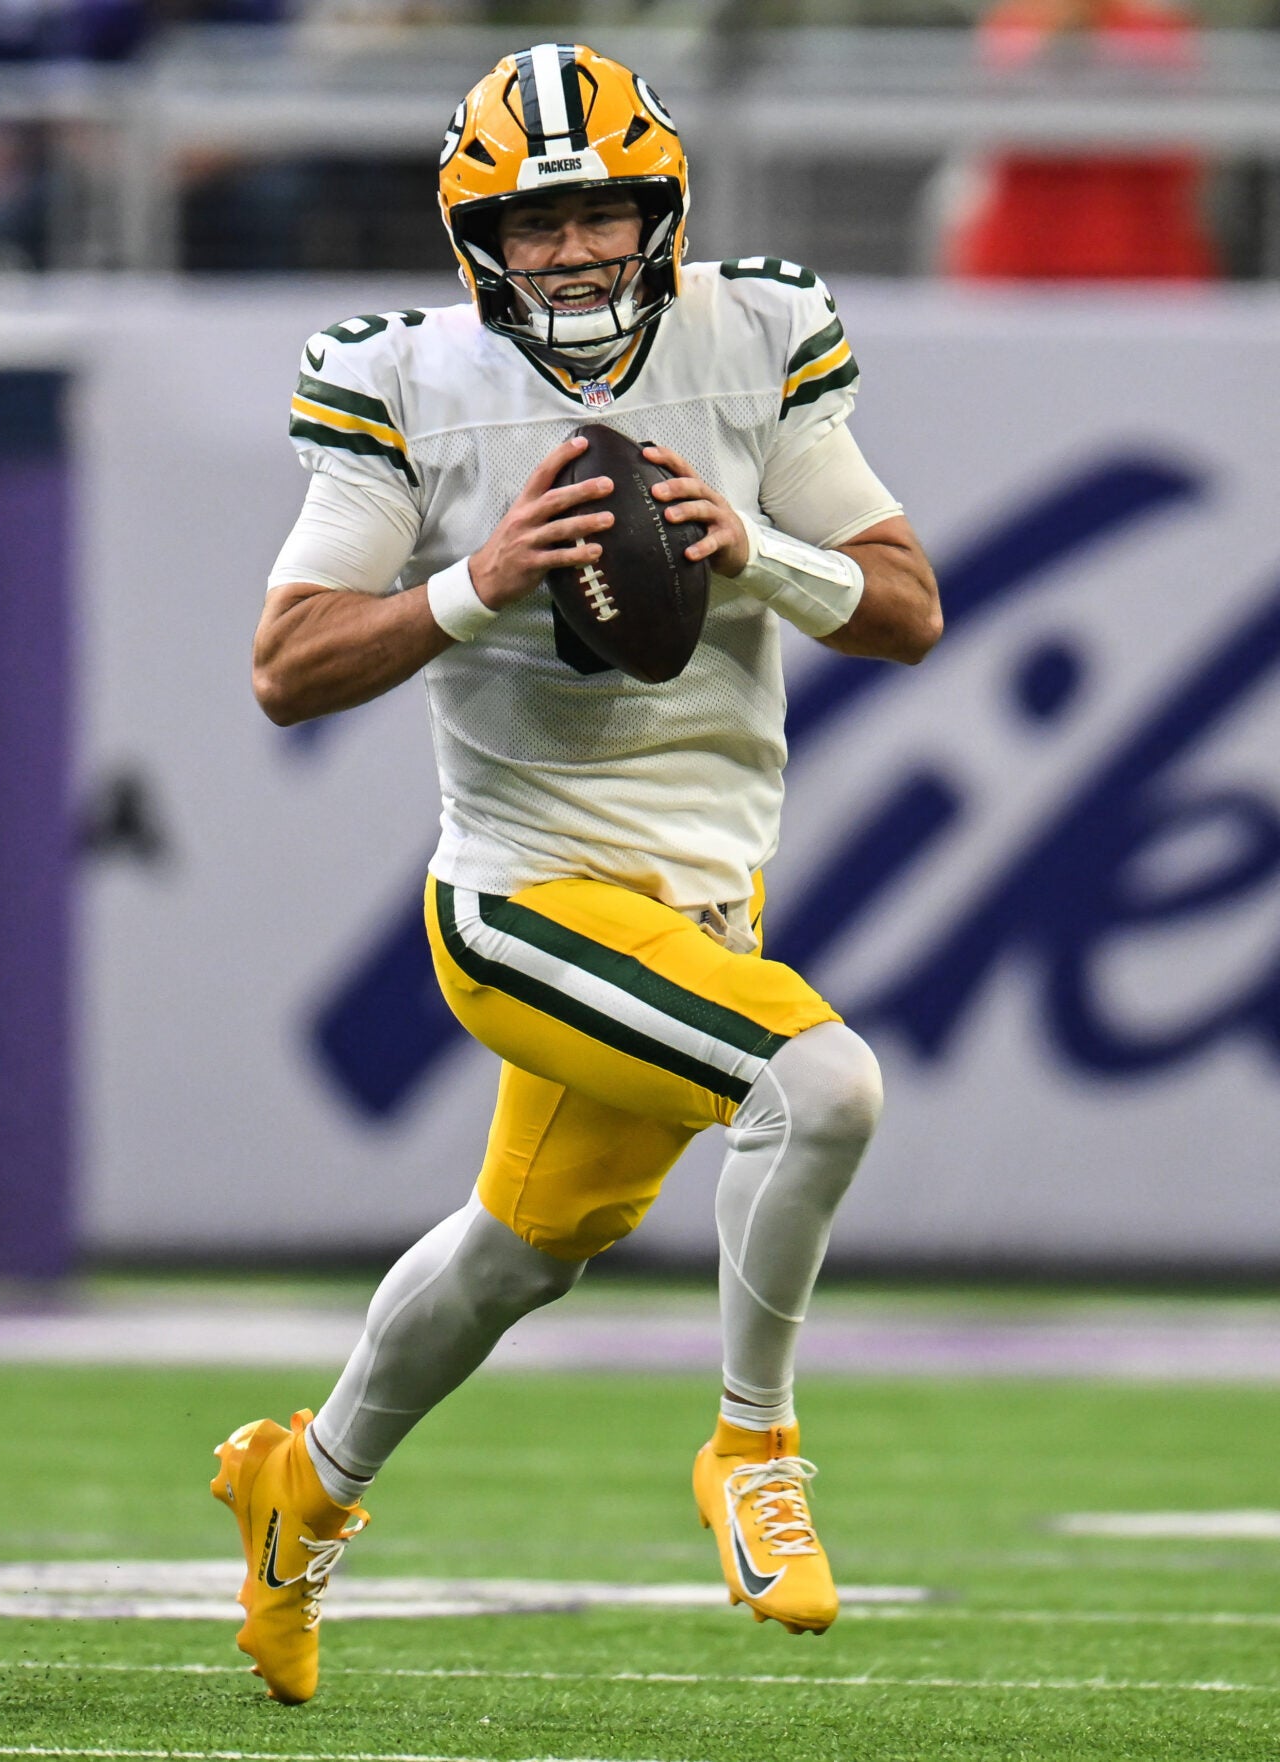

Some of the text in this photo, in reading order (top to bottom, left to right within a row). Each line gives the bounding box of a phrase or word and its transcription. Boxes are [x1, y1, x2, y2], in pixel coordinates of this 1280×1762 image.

[537, 157, 583, 175] PACKERS
[587, 390, 609, 405] NFL
[632, 472, 658, 512] LEAGUE
[652, 512, 676, 570] FOOTBALL
